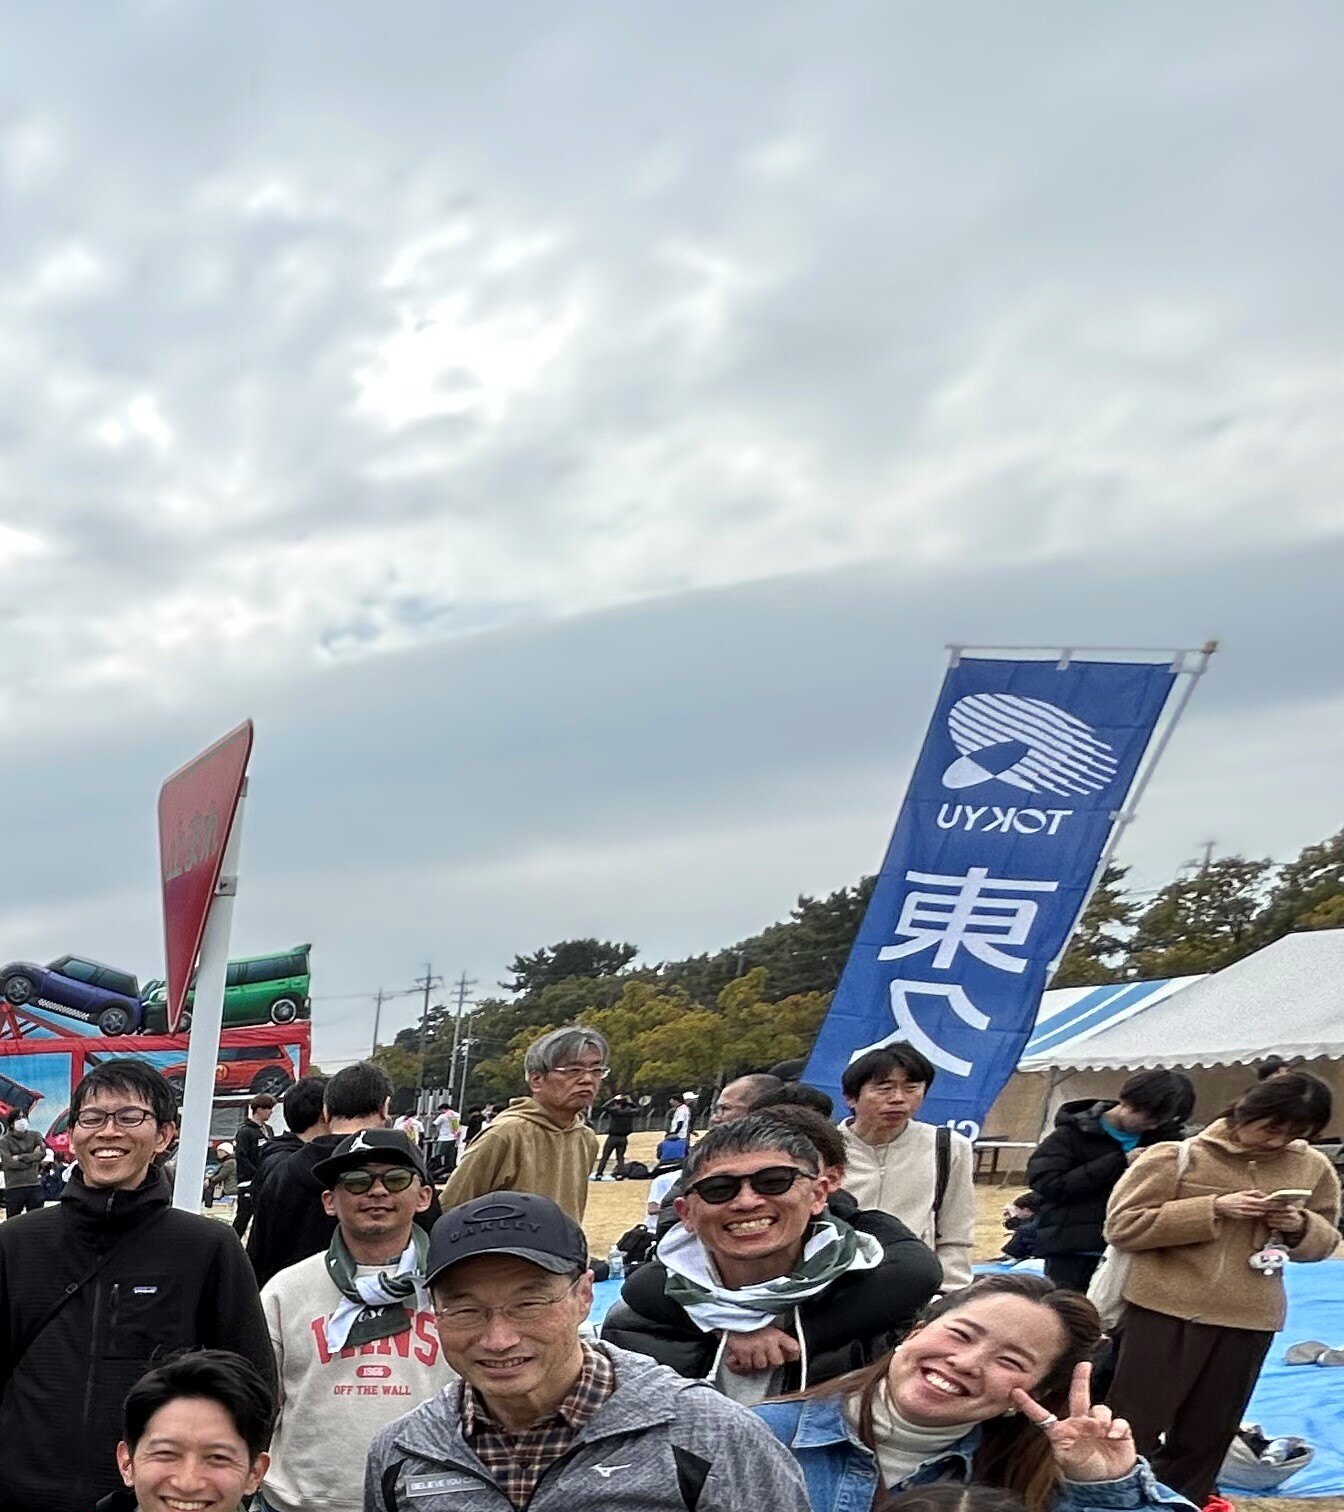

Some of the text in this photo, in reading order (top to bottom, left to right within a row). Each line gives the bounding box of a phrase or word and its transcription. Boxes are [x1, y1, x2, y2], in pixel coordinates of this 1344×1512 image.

[450, 1219, 542, 1243] OAKLEY
[333, 1385, 412, 1396] OFF THE WALL
